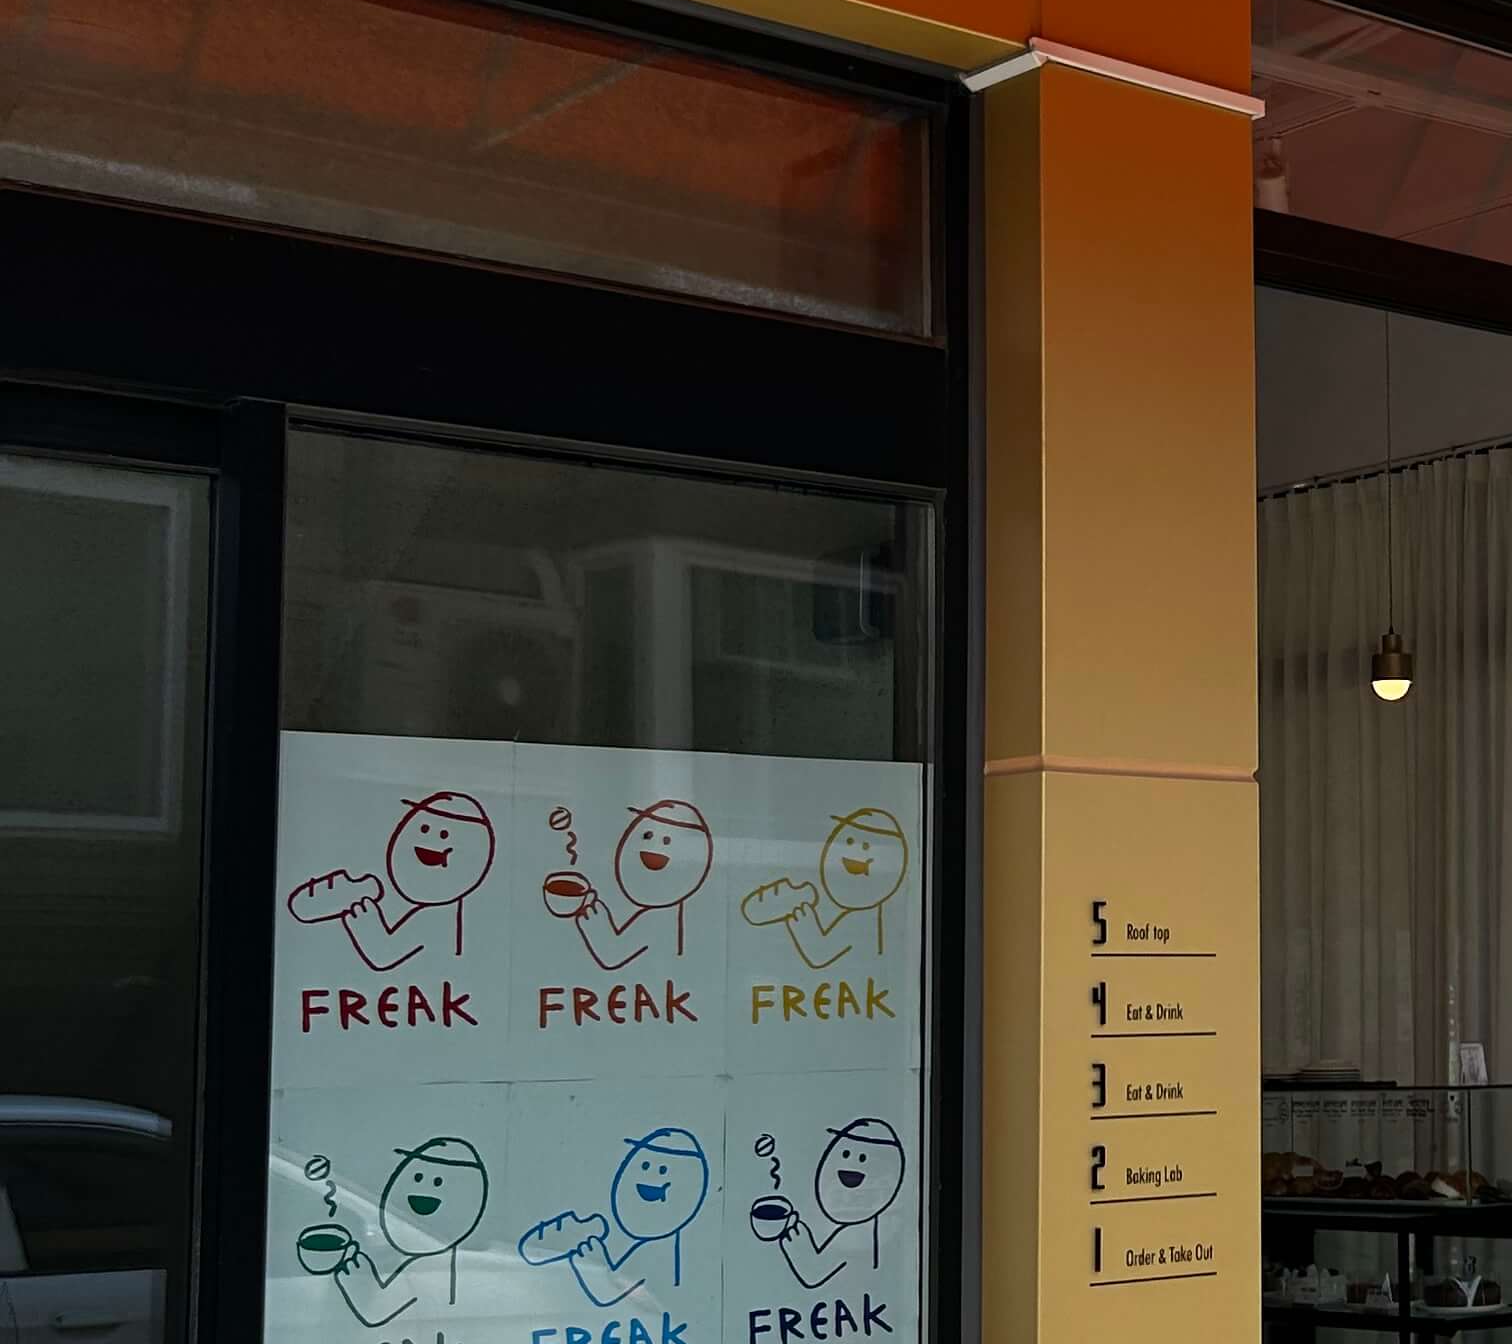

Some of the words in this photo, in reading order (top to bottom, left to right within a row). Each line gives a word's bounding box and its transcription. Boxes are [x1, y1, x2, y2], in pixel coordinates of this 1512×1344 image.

[1092, 901, 1107, 944] 5
[1127, 923, 1149, 941] Roof
[1153, 925, 1170, 944] top
[301, 981, 478, 1032] FREAK
[539, 980, 698, 1029] FREAK
[751, 978, 896, 1024] FREAK
[1092, 982, 1106, 1026] 4
[1127, 1003, 1142, 1020] Eat
[1145, 1004, 1153, 1020] &
[1156, 1003, 1183, 1020] Drink
[1092, 1063, 1106, 1108] 3
[1127, 1083, 1142, 1101] Eat
[1145, 1083, 1153, 1100] &
[1156, 1082, 1183, 1100] Drink
[1091, 1145, 1106, 1191] 2
[1126, 1167, 1161, 1187] Baking
[1164, 1165, 1183, 1182] Lab
[1094, 1227, 1101, 1272] 1
[1126, 1248, 1155, 1267] Order
[1158, 1248, 1167, 1265] &
[1169, 1245, 1192, 1263] Take
[1195, 1244, 1213, 1261] Out
